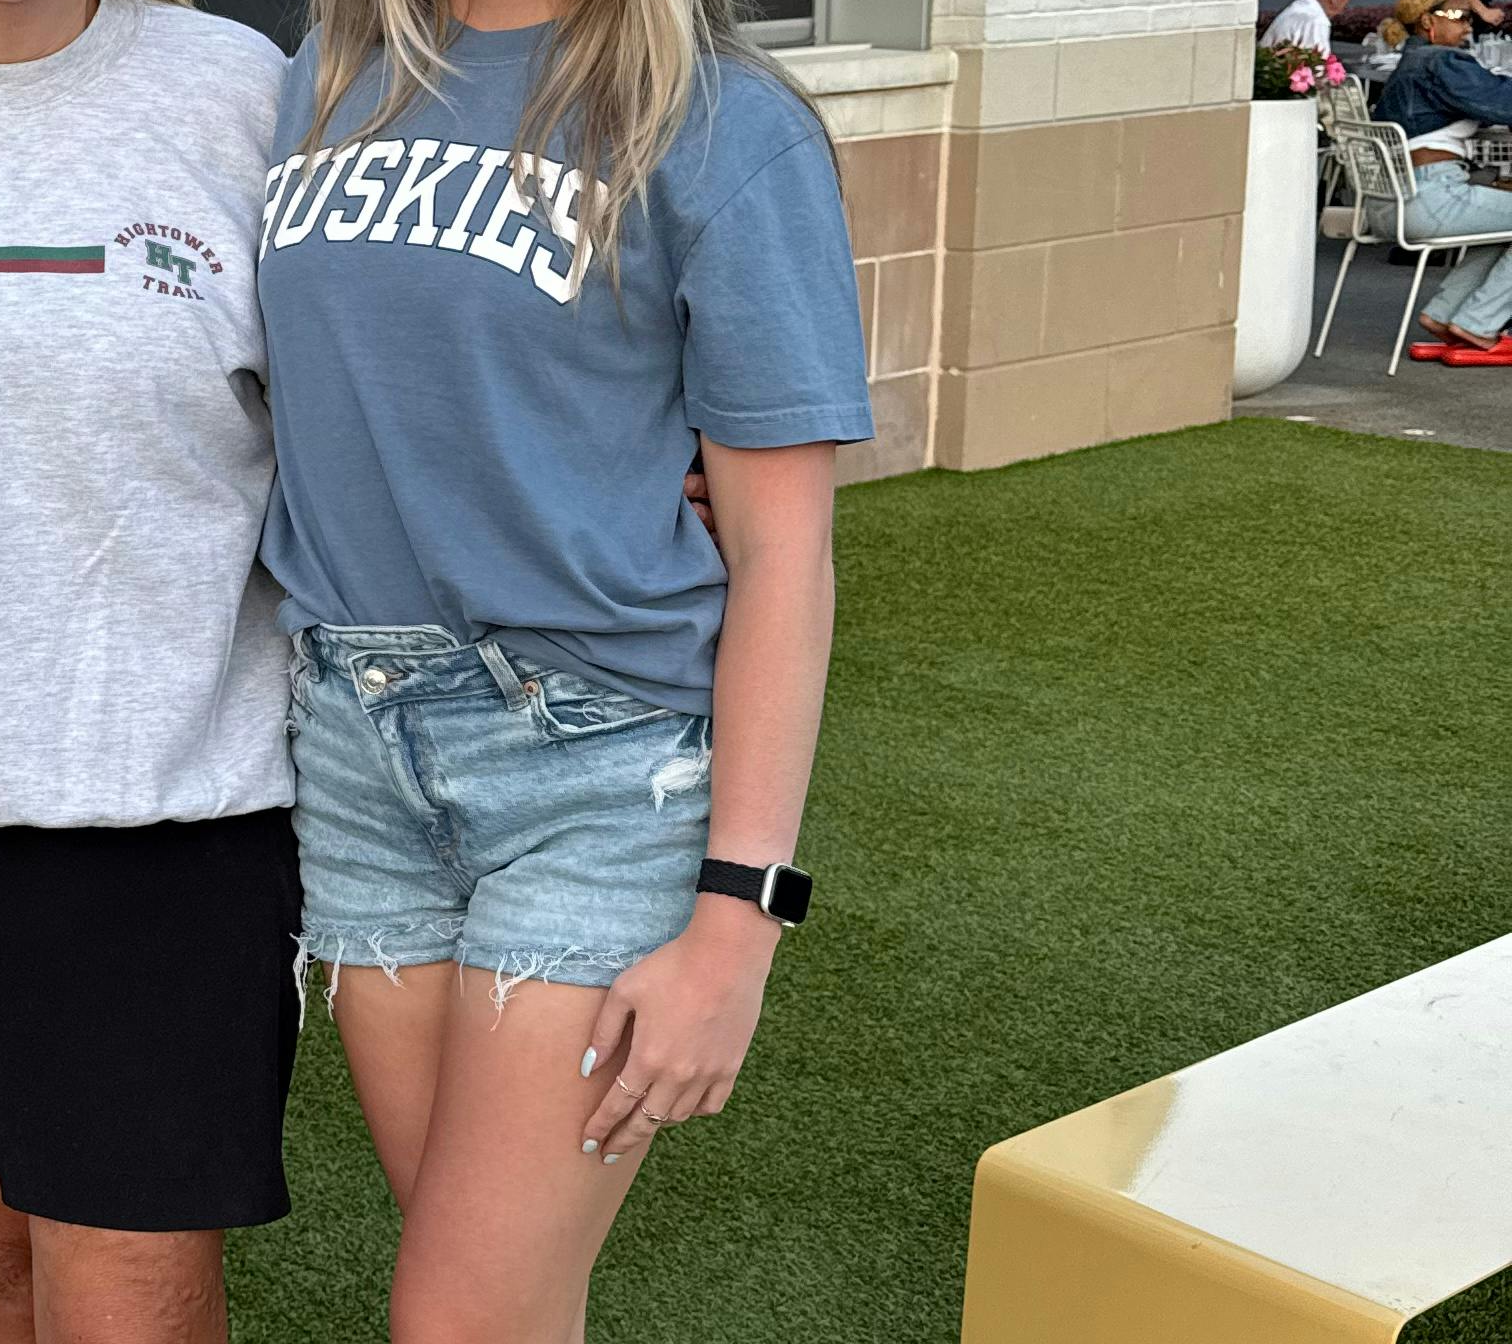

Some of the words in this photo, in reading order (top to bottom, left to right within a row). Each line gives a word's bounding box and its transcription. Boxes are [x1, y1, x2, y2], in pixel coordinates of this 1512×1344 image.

[114, 222, 223, 274] HIGHTOWER
[144, 238, 197, 287] HT
[142, 274, 205, 300] TRAIL
